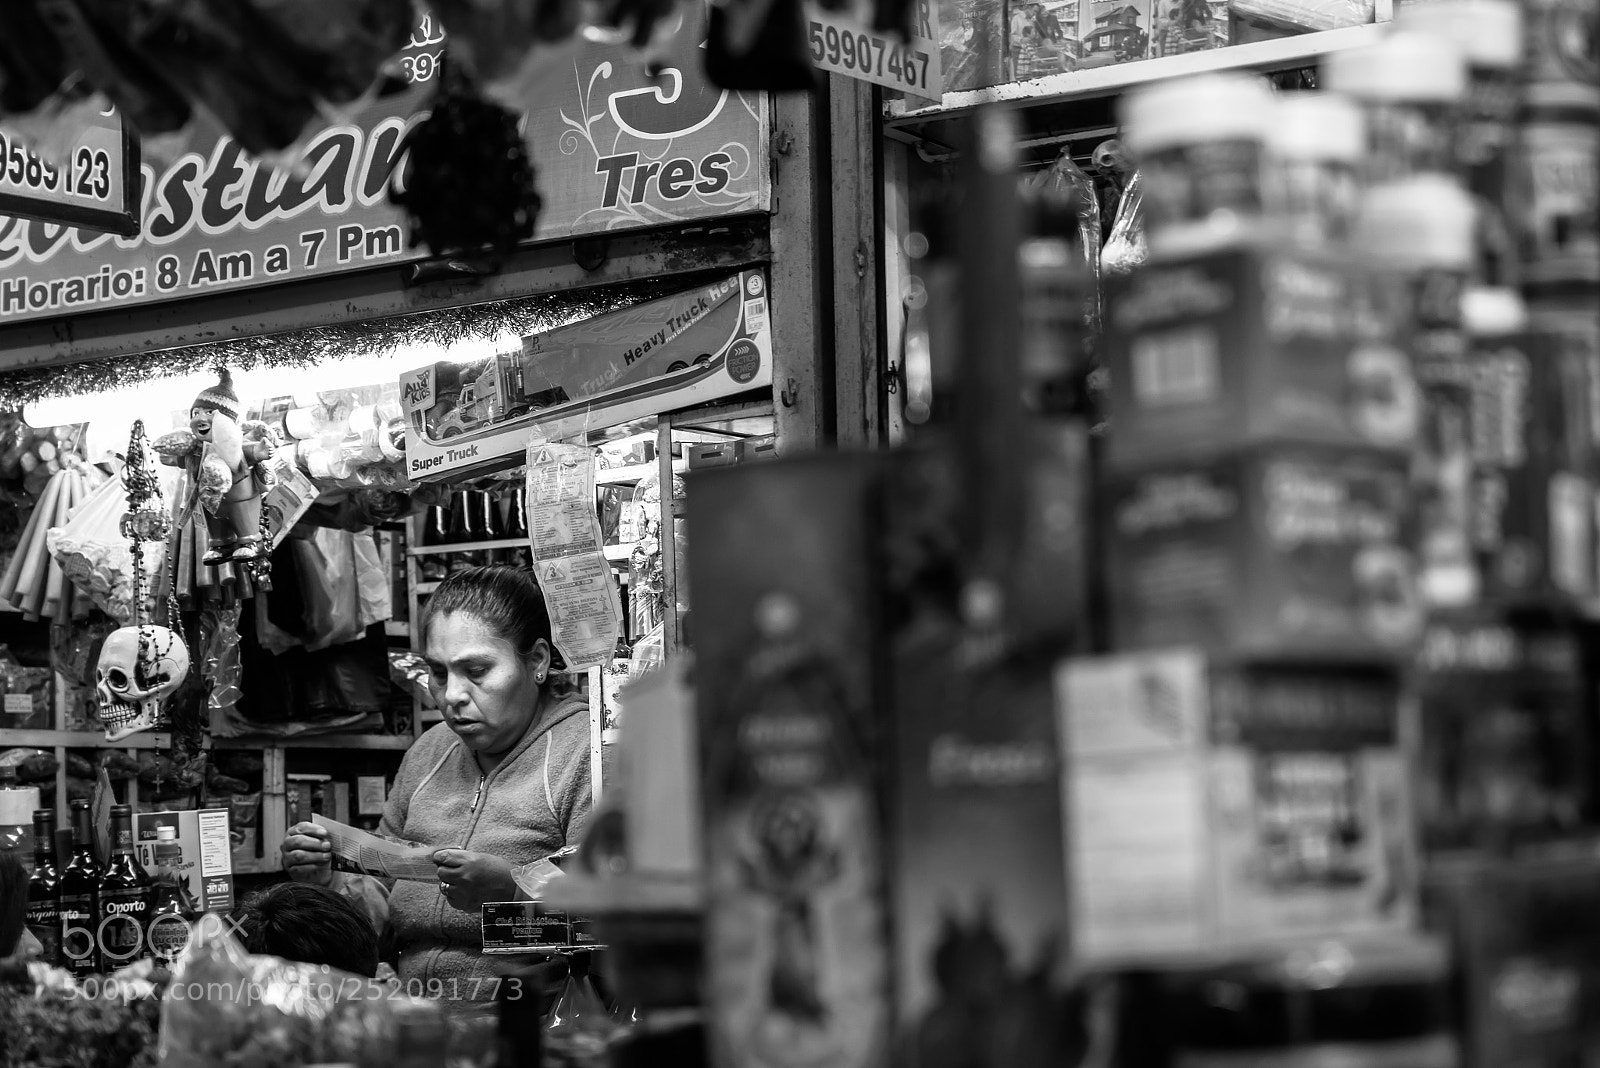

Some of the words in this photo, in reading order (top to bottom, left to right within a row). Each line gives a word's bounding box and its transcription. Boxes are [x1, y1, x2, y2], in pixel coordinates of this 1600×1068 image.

[809, 21, 929, 89] 59907467
[595, 151, 732, 208] Tres
[2, 265, 145, 315] Horario:
[156, 254, 180, 293] 8
[190, 248, 254, 287] Am
[264, 244, 290, 275] a
[299, 229, 326, 268] 7
[337, 222, 402, 262] Pm
[623, 328, 667, 366] Heavy
[666, 297, 710, 332] Truck
[728, 354, 758, 367] FRICTION
[731, 361, 757, 375] POWER
[411, 455, 444, 472] Super
[446, 444, 479, 462] Truck
[549, 566, 557, 578] 3
[136, 844, 149, 867] Té
[106, 900, 146, 917] Oporto
